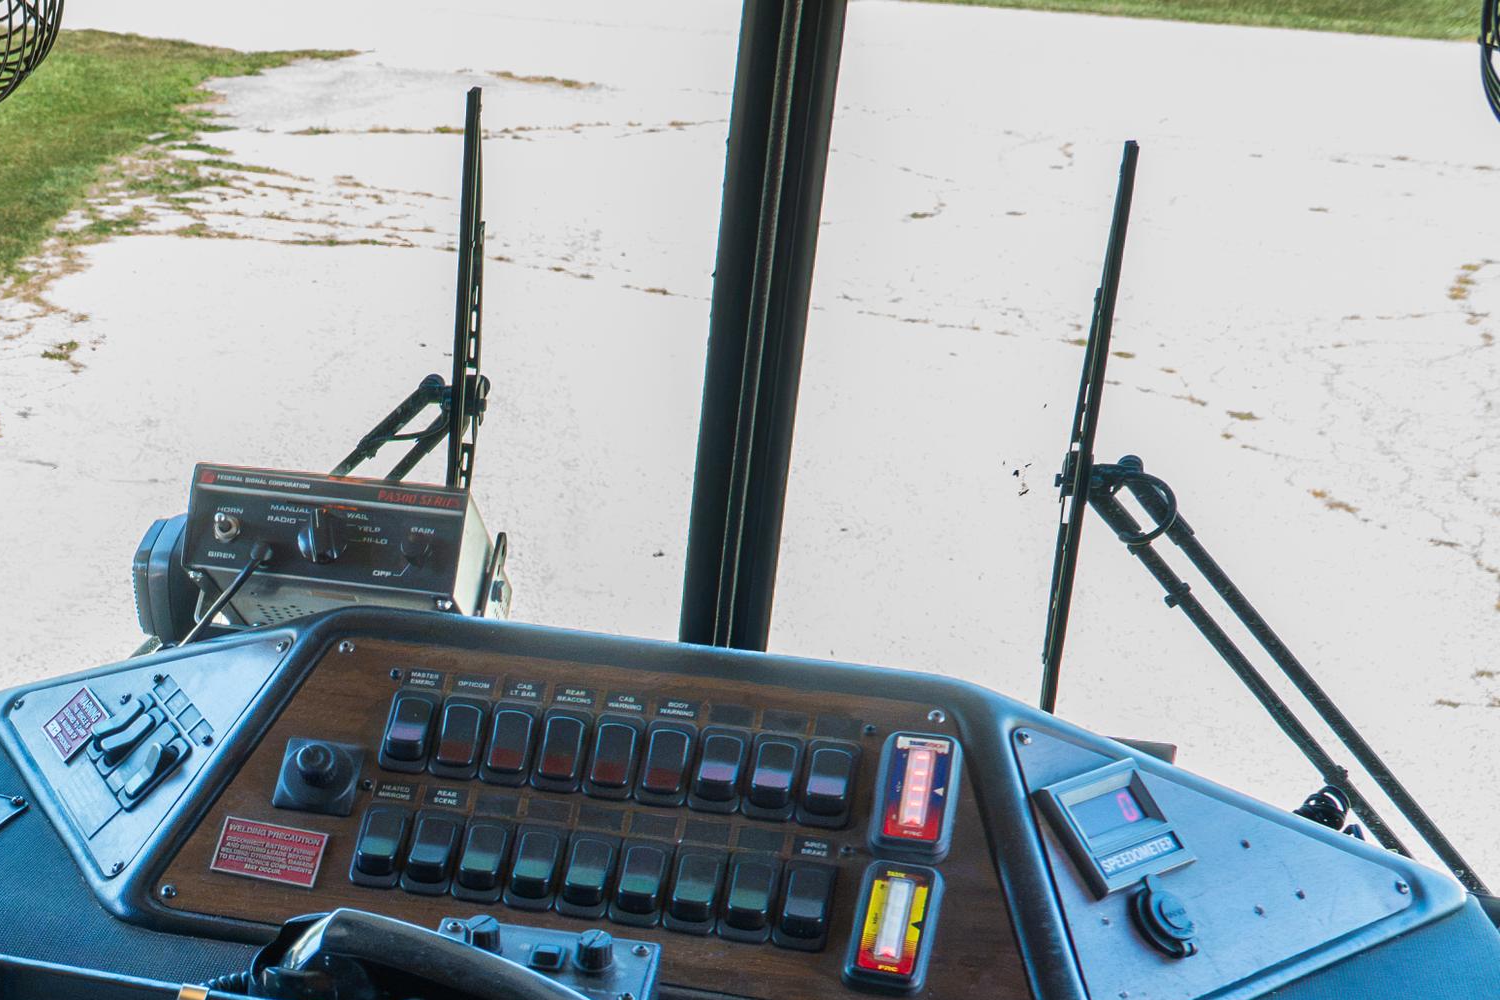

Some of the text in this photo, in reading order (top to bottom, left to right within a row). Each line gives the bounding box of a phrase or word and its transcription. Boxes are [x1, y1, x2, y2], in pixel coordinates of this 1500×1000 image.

[217, 506, 244, 514] HORN
[270, 504, 311, 514] MANUAL
[267, 515, 296, 524] RADIO
[347, 512, 369, 521] WAIL
[363, 537, 388, 545] HI-LO
[208, 551, 235, 559] SIREN
[411, 671, 439, 680] MASTER
[458, 680, 490, 689] OPTICOM
[517, 682, 532, 690] CAB
[566, 689, 585, 697] REAR
[618, 695, 634, 703] CAB
[608, 702, 642, 711] WARNING
[667, 701, 688, 709] BODY
[659, 708, 694, 717] WARNING
[437, 789, 457, 797] REAR
[434, 796, 457, 805] SCENE
[228, 823, 320, 846] WELDING PRECAUTION
[1100, 836, 1175, 873] SPEEDOMETER
